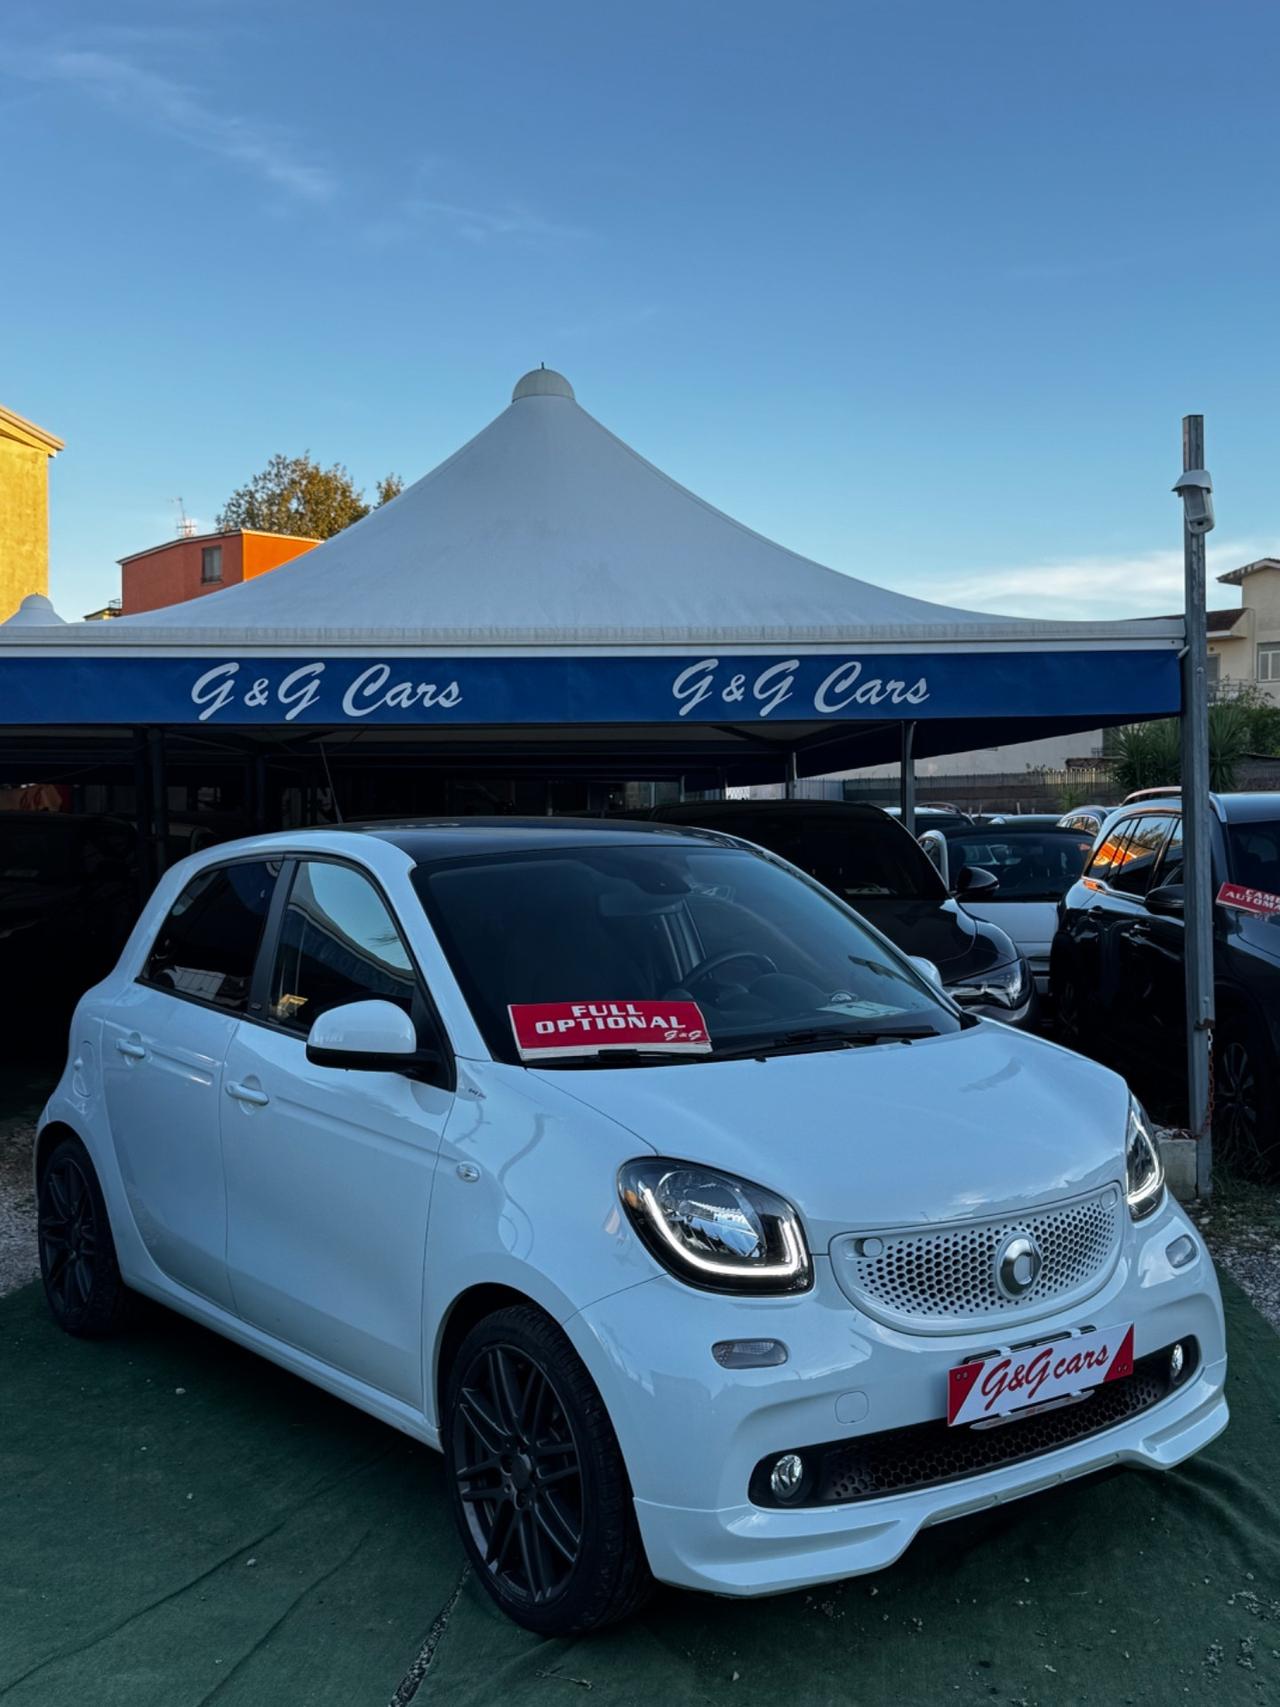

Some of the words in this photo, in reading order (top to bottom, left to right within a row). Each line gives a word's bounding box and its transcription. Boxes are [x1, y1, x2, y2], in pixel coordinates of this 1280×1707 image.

[342, 663, 463, 717] Cars
[814, 661, 930, 713] Cars
[535, 1016, 686, 1034] OPTIONAL
[571, 1004, 643, 1017] FULL
